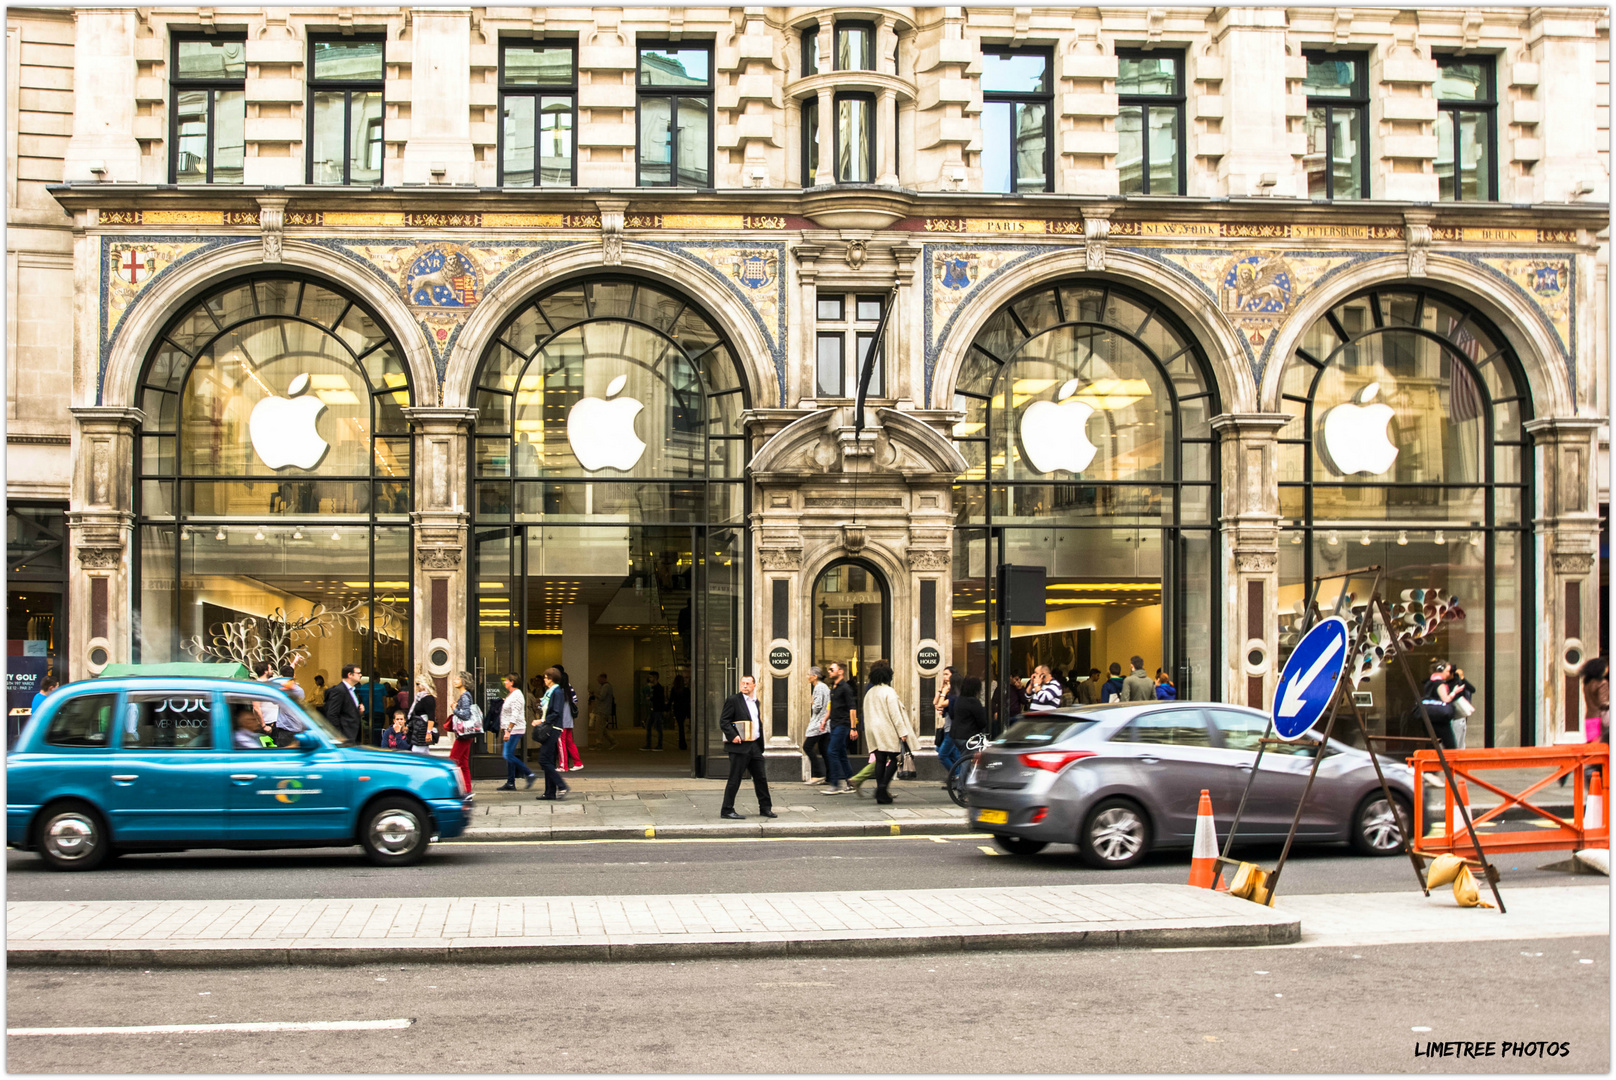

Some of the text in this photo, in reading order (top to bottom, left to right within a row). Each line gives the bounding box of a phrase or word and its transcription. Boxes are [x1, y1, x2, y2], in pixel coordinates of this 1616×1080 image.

[987, 222, 1025, 231] PARIS
[1146, 225, 1214, 234] NEW YORK
[1307, 226, 1363, 237] PETERSBURG
[1482, 230, 1517, 240] BERLIN
[426, 258, 441, 268] VR
